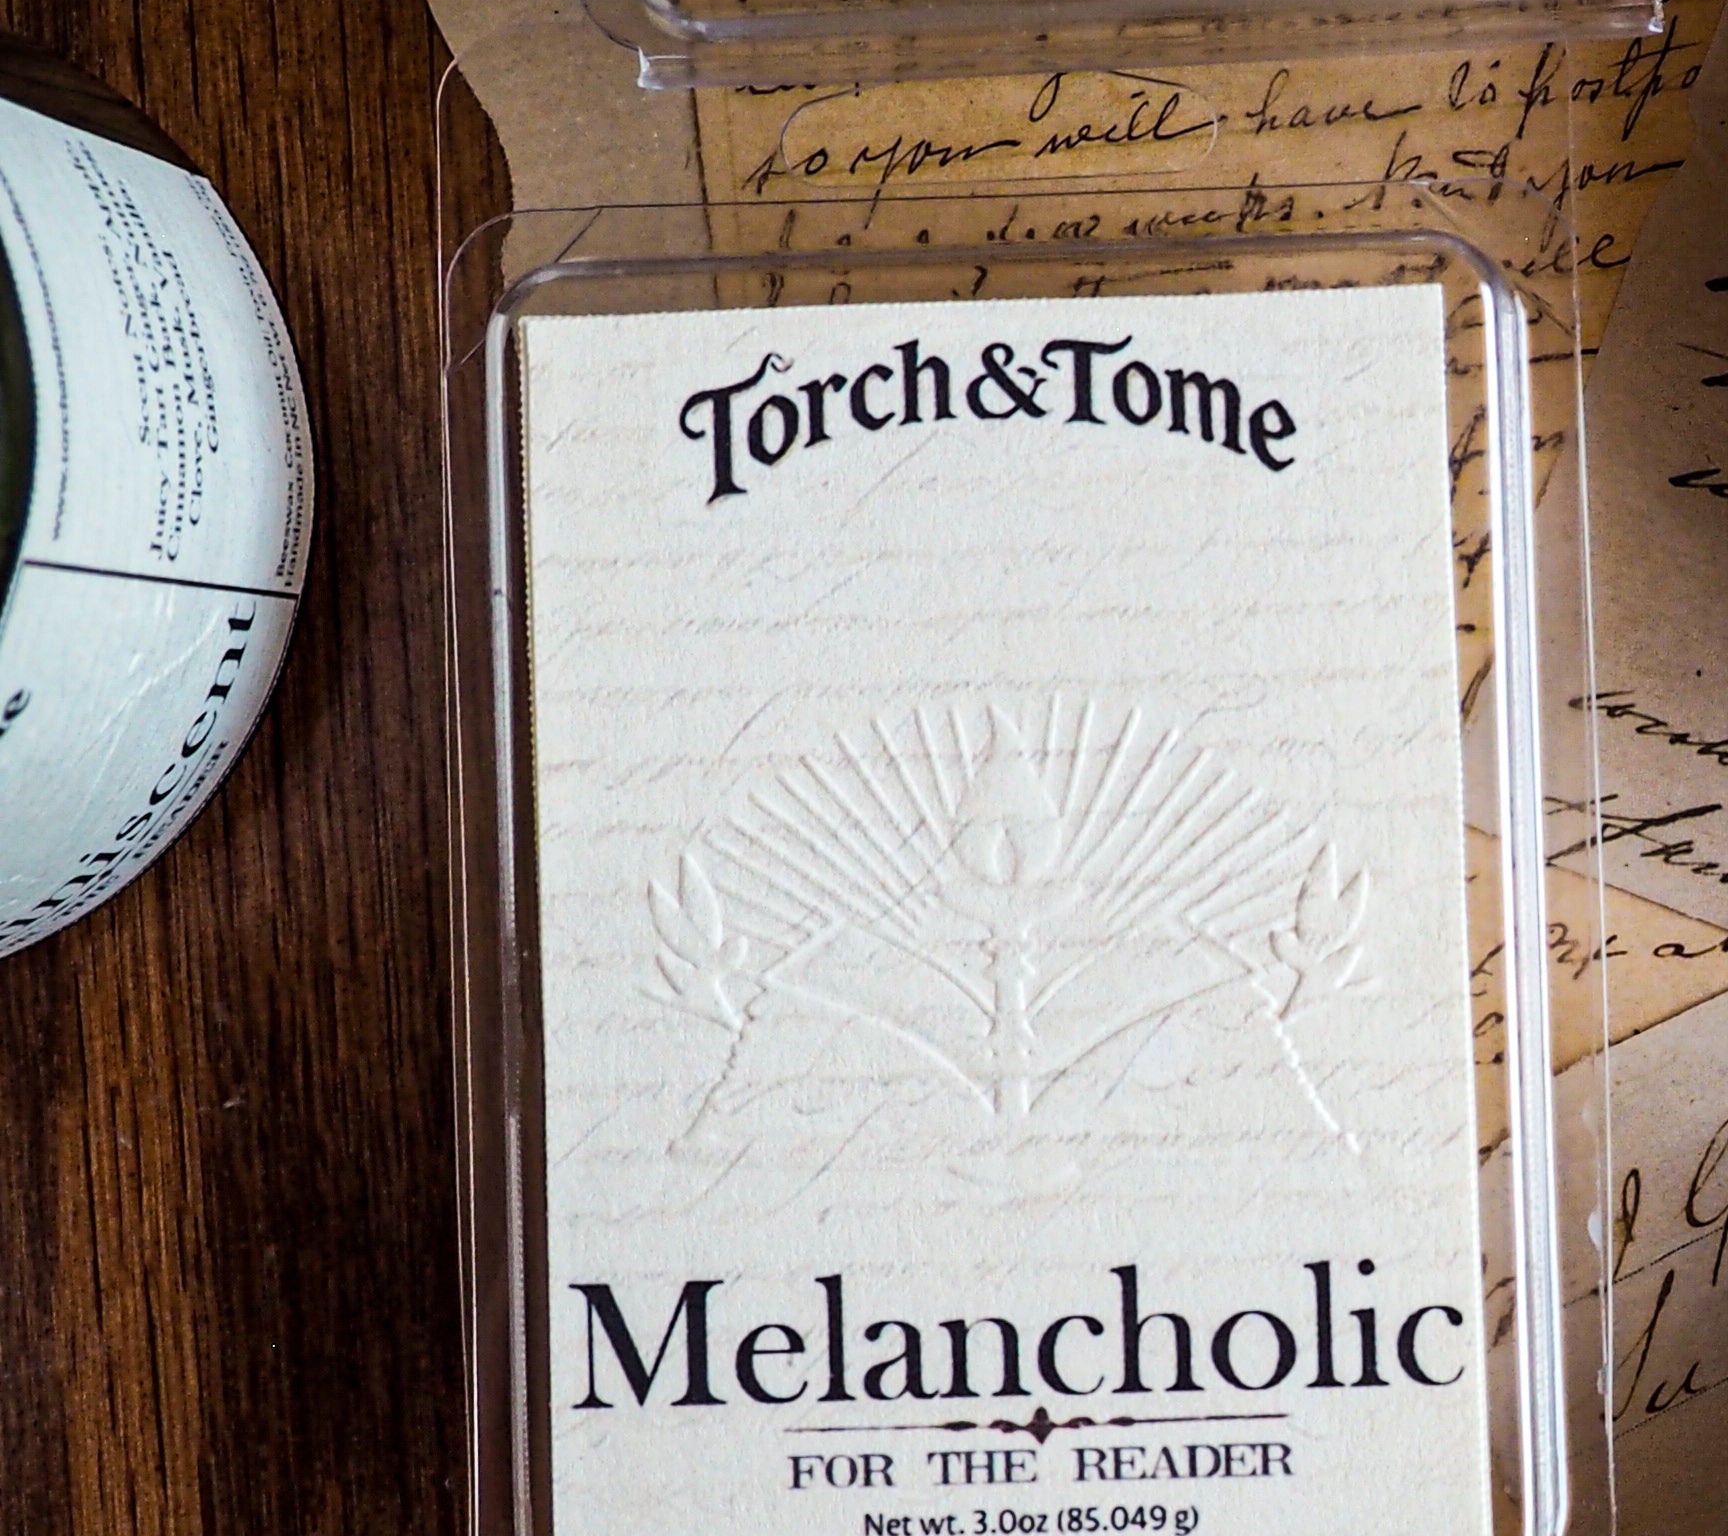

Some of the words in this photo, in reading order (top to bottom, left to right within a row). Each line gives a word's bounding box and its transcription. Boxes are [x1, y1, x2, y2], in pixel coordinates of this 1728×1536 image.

[129, 352, 152, 447] Scent
[160, 249, 221, 455] Gingerbread
[154, 385, 170, 460] Tart
[679, 335, 1296, 504] Torch&Tome
[147, 470, 171, 561] Juicy
[164, 382, 186, 562] Cinnamon
[186, 420, 205, 527] Clove,
[569, 1259, 1463, 1406] Melancholic
[789, 1454, 893, 1489] FOR
[928, 1450, 1036, 1485] THE
[1074, 1443, 1291, 1481] READER
[918, 1513, 966, 1536] wt.
[972, 1507, 1049, 1536] 3.0oz
